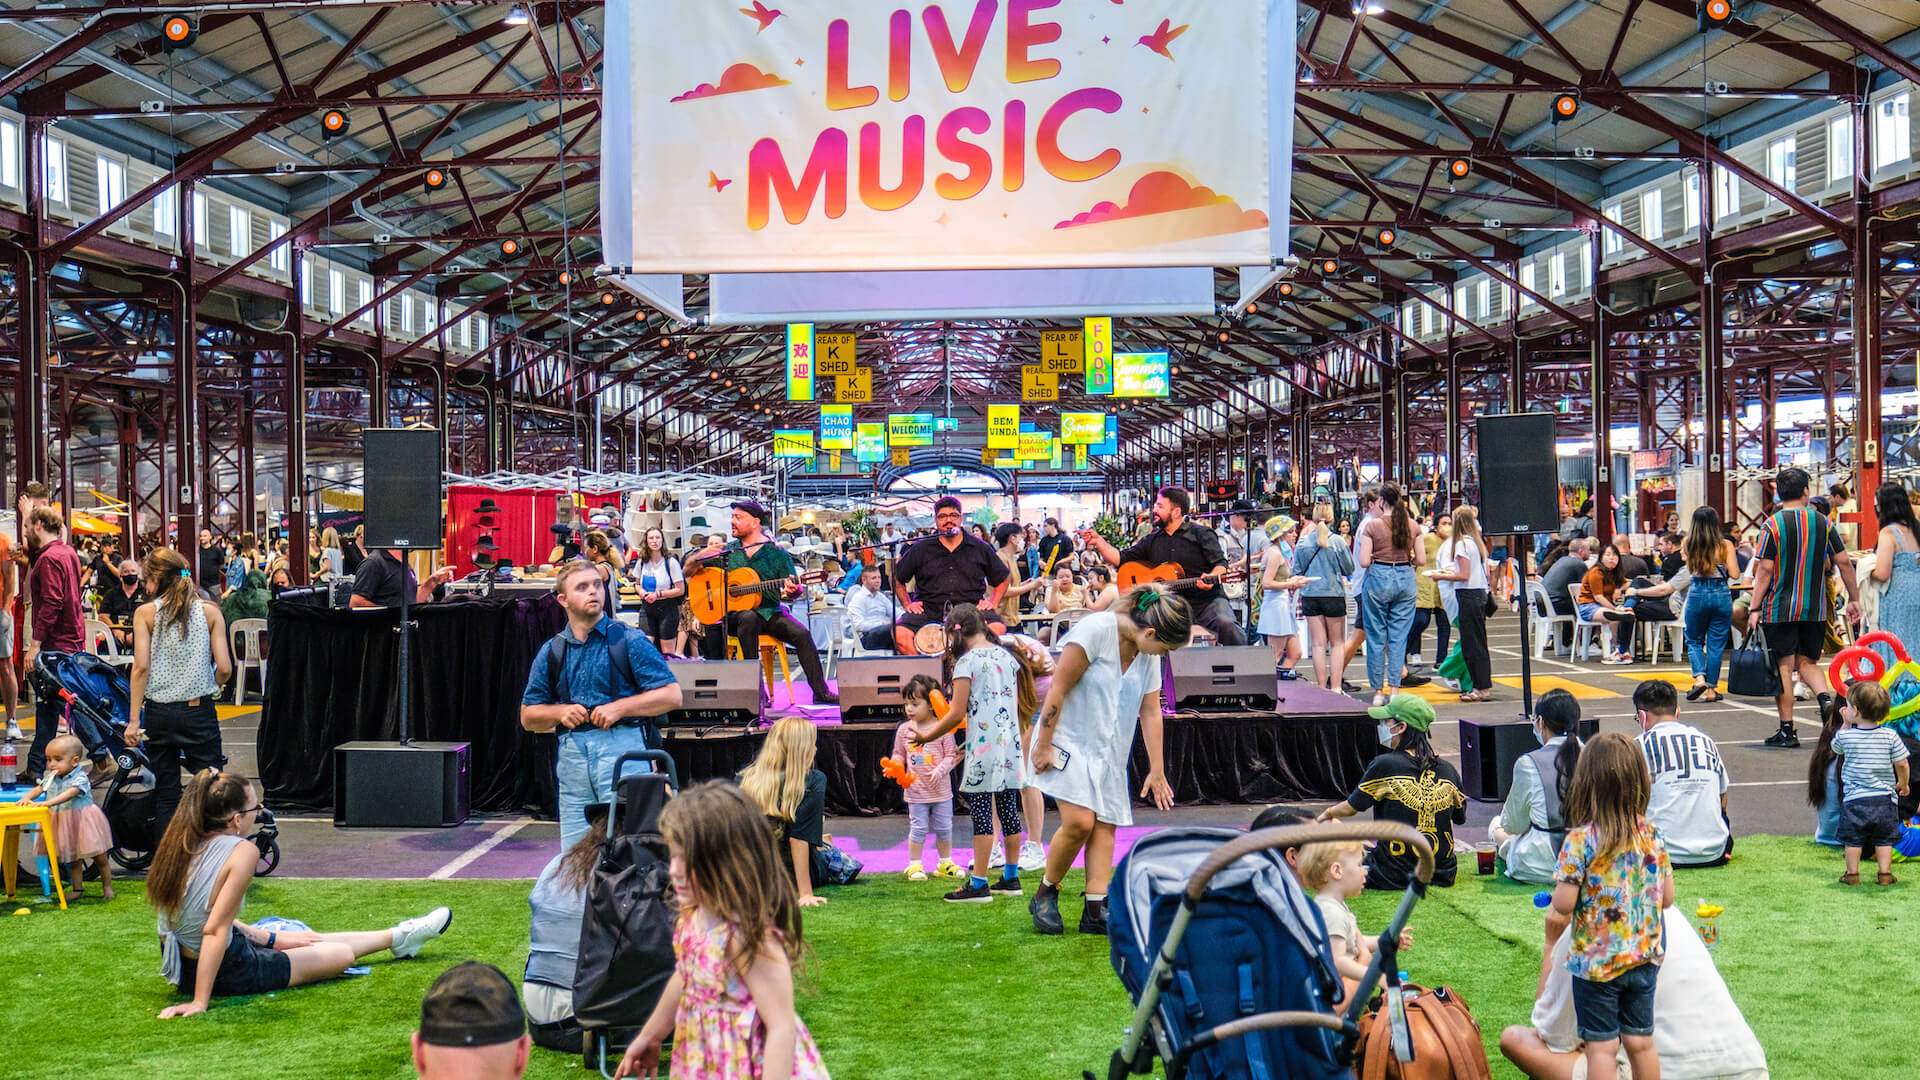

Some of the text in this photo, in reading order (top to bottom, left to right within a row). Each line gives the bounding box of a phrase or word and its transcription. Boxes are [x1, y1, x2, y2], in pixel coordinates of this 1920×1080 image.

[826, 0, 1062, 111] LIVE
[746, 87, 1123, 231] MUSIC
[817, 336, 851, 344] REAR OF
[1045, 333, 1079, 341] REAR OF
[829, 346, 839, 359] K
[1057, 343, 1068, 356] L
[1094, 324, 1105, 386] FOOD
[793, 344, 808, 379] 欢迎
[1048, 359, 1077, 370] SHED
[820, 362, 849, 372] SHED
[1025, 367, 1042, 375] REA
[848, 378, 858, 389] K
[1035, 375, 1045, 386] L
[841, 391, 866, 400] SHED
[1028, 388, 1053, 398] SHED
[993, 417, 1013, 426] BEM
[891, 425, 932, 435] WELCOME
[989, 427, 1018, 437] VINDA
